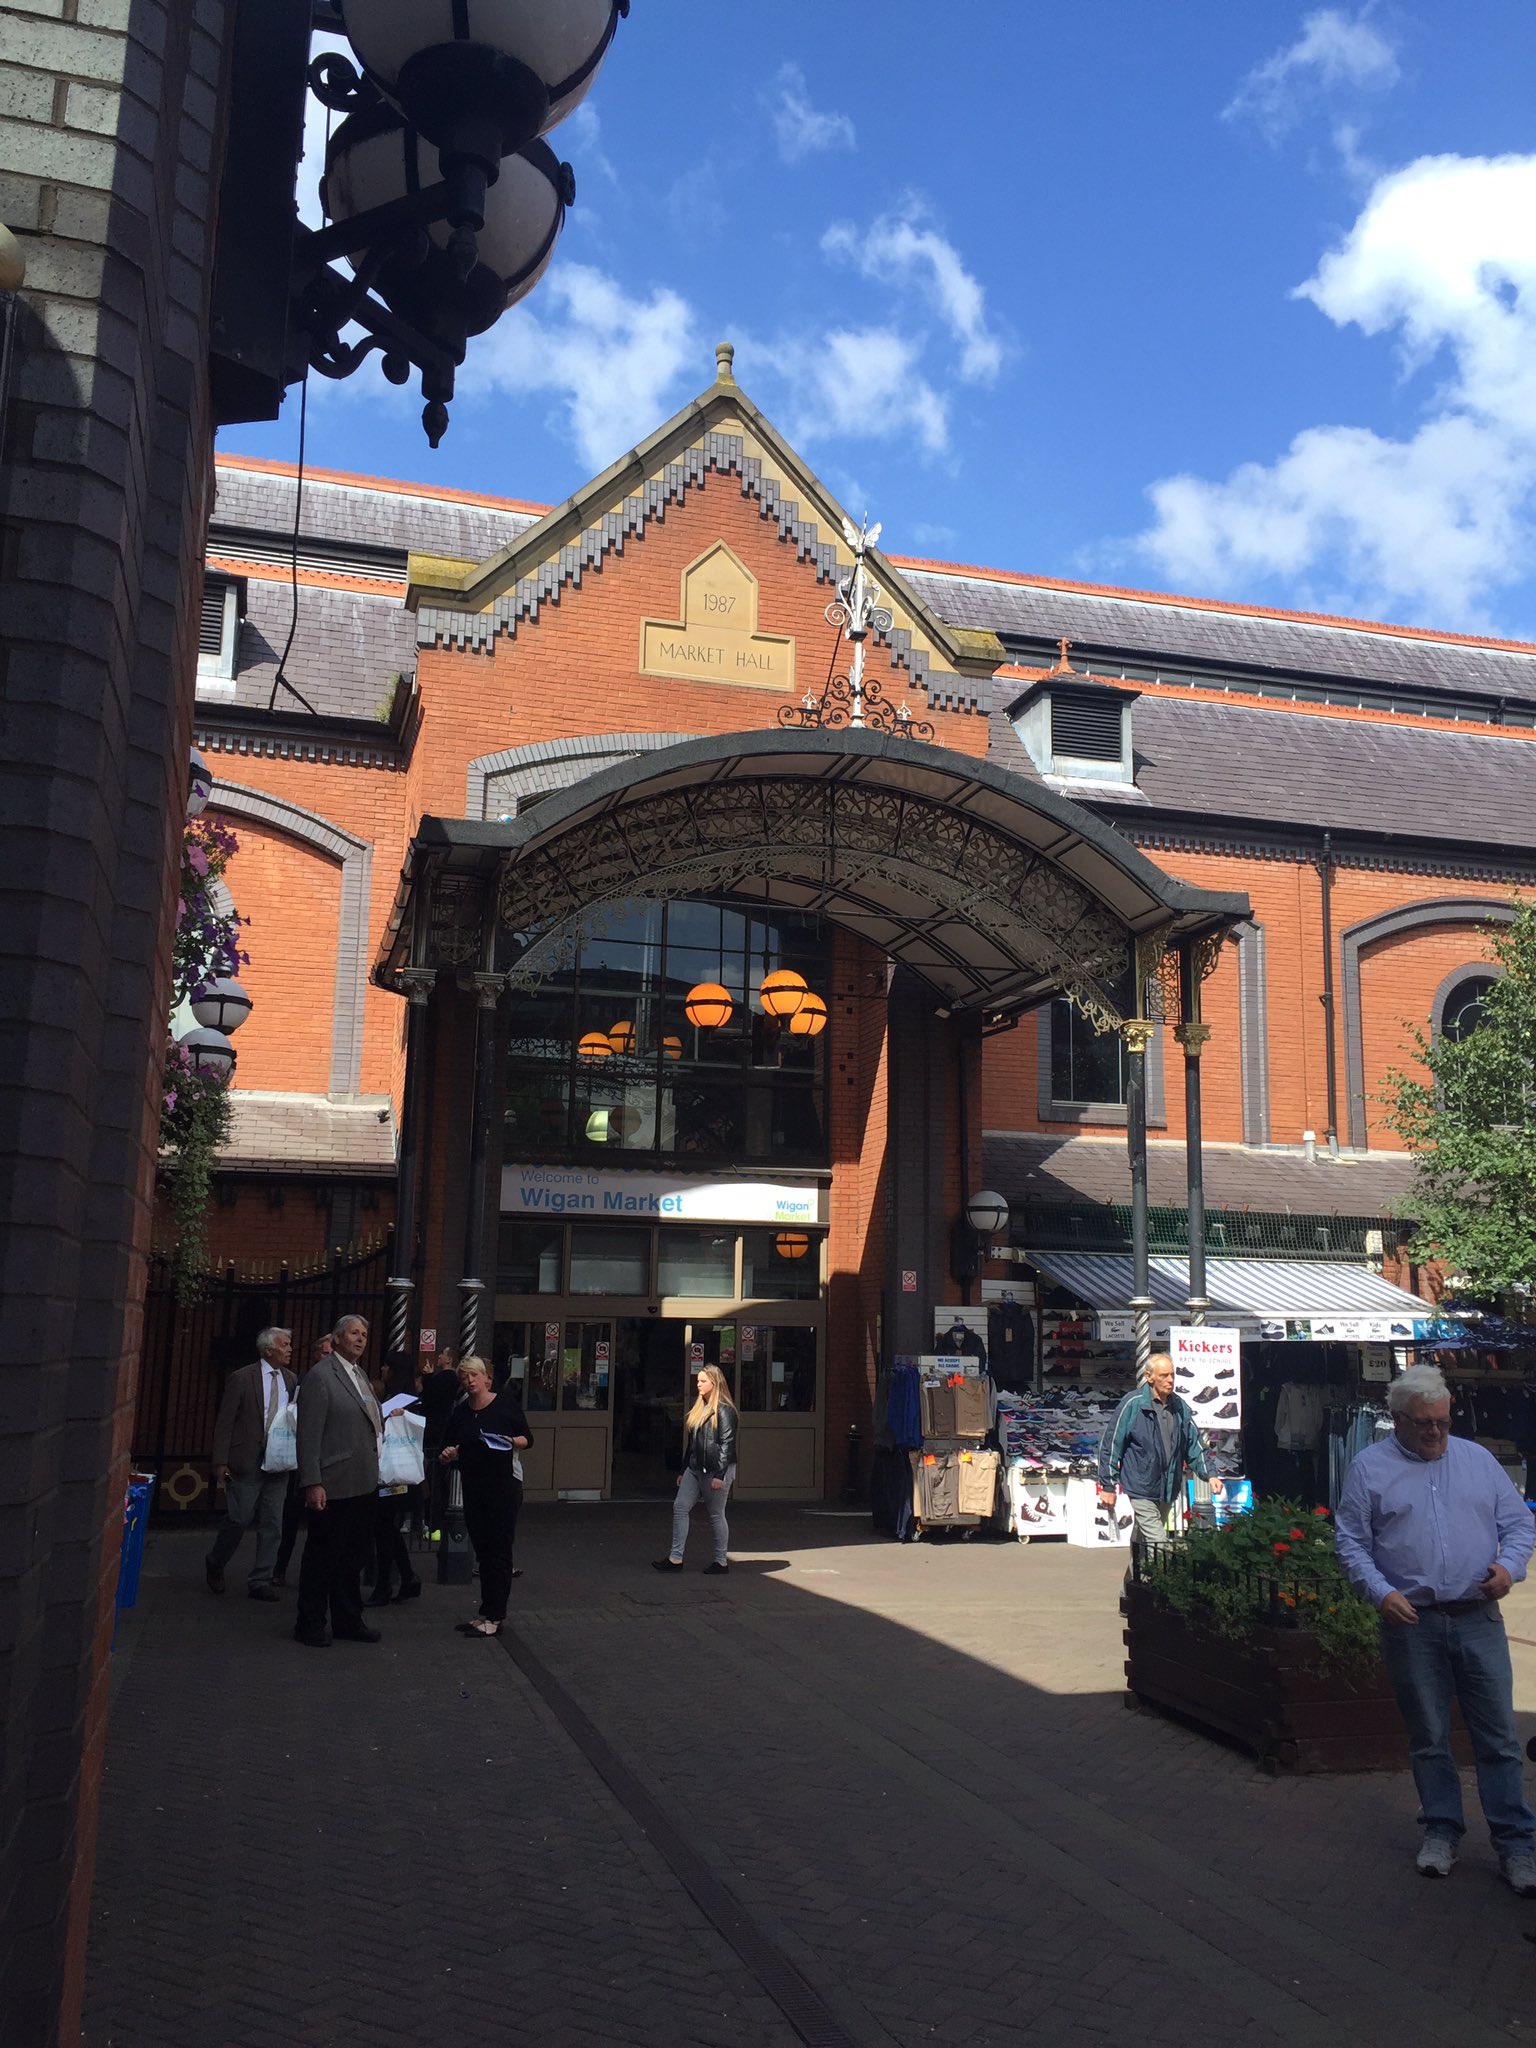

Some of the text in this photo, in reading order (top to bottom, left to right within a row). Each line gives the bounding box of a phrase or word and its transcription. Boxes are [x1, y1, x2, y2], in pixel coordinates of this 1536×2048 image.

[703, 593, 737, 614] 1987
[659, 641, 775, 671] MARKET HALL
[521, 1170, 600, 1185] Welcome to
[520, 1187, 683, 1213] Wigan Market
[776, 1200, 810, 1212] Wigan
[775, 1211, 811, 1221] Market
[1178, 1339, 1233, 1354] Kickers
[1369, 1360, 1387, 1368] £20
